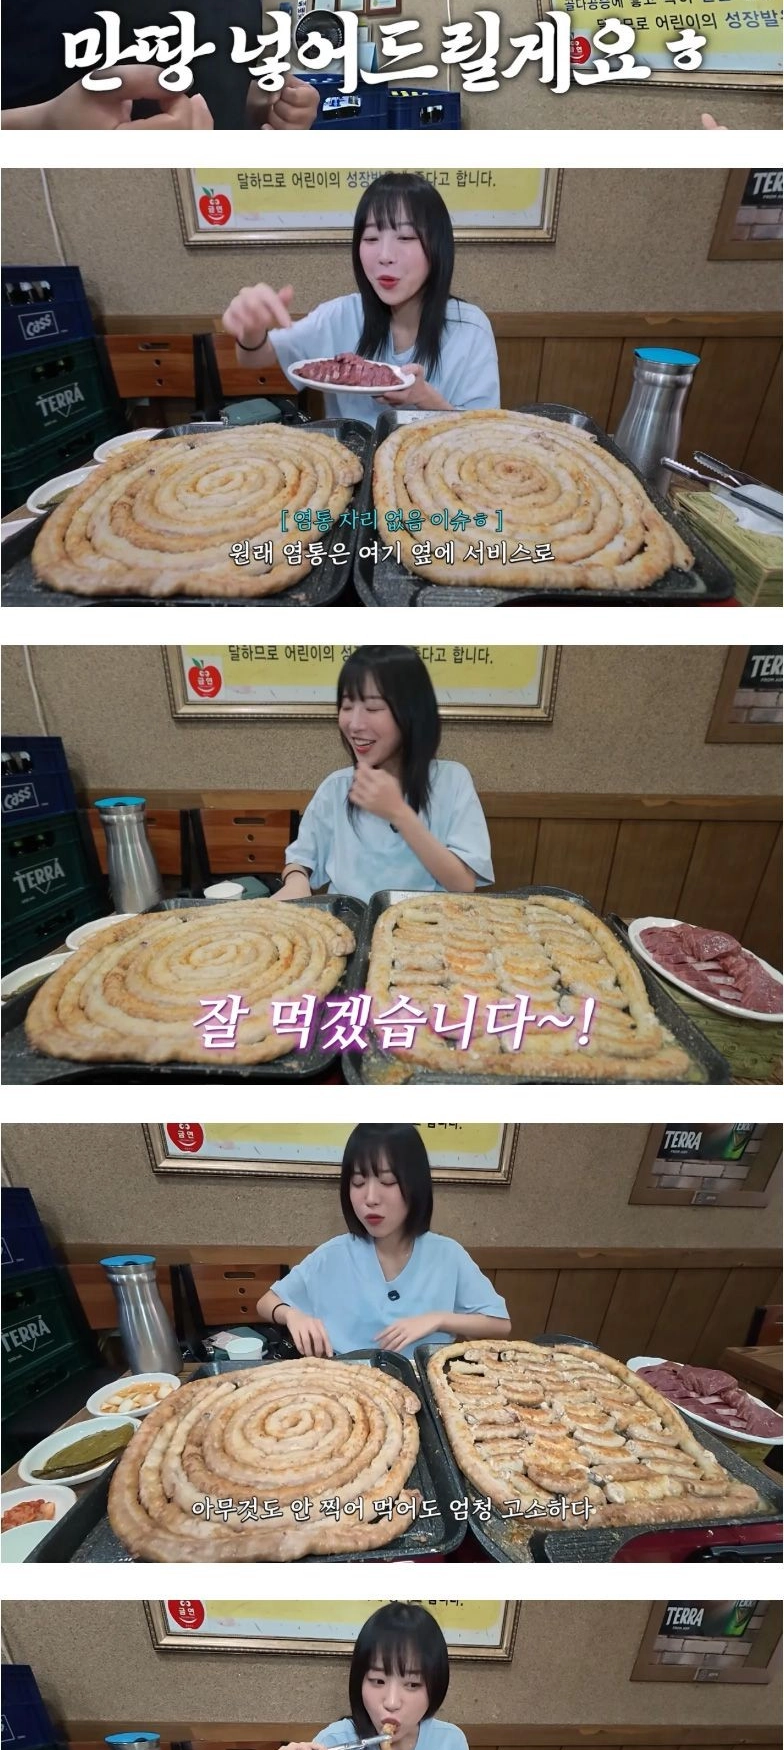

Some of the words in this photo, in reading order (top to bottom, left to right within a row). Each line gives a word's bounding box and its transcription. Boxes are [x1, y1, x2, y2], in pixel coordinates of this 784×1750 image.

[237, 171, 286, 190] 달하므로
[292, 171, 341, 189] 어린이의
[456, 171, 497, 188] 합니다.
[35, 385, 85, 417] TERRA
[453, 646, 494, 664] 합니다.
[13, 861, 66, 893] TERRA
[664, 1131, 702, 1150] TERRA
[666, 1607, 704, 1626] TERRA
